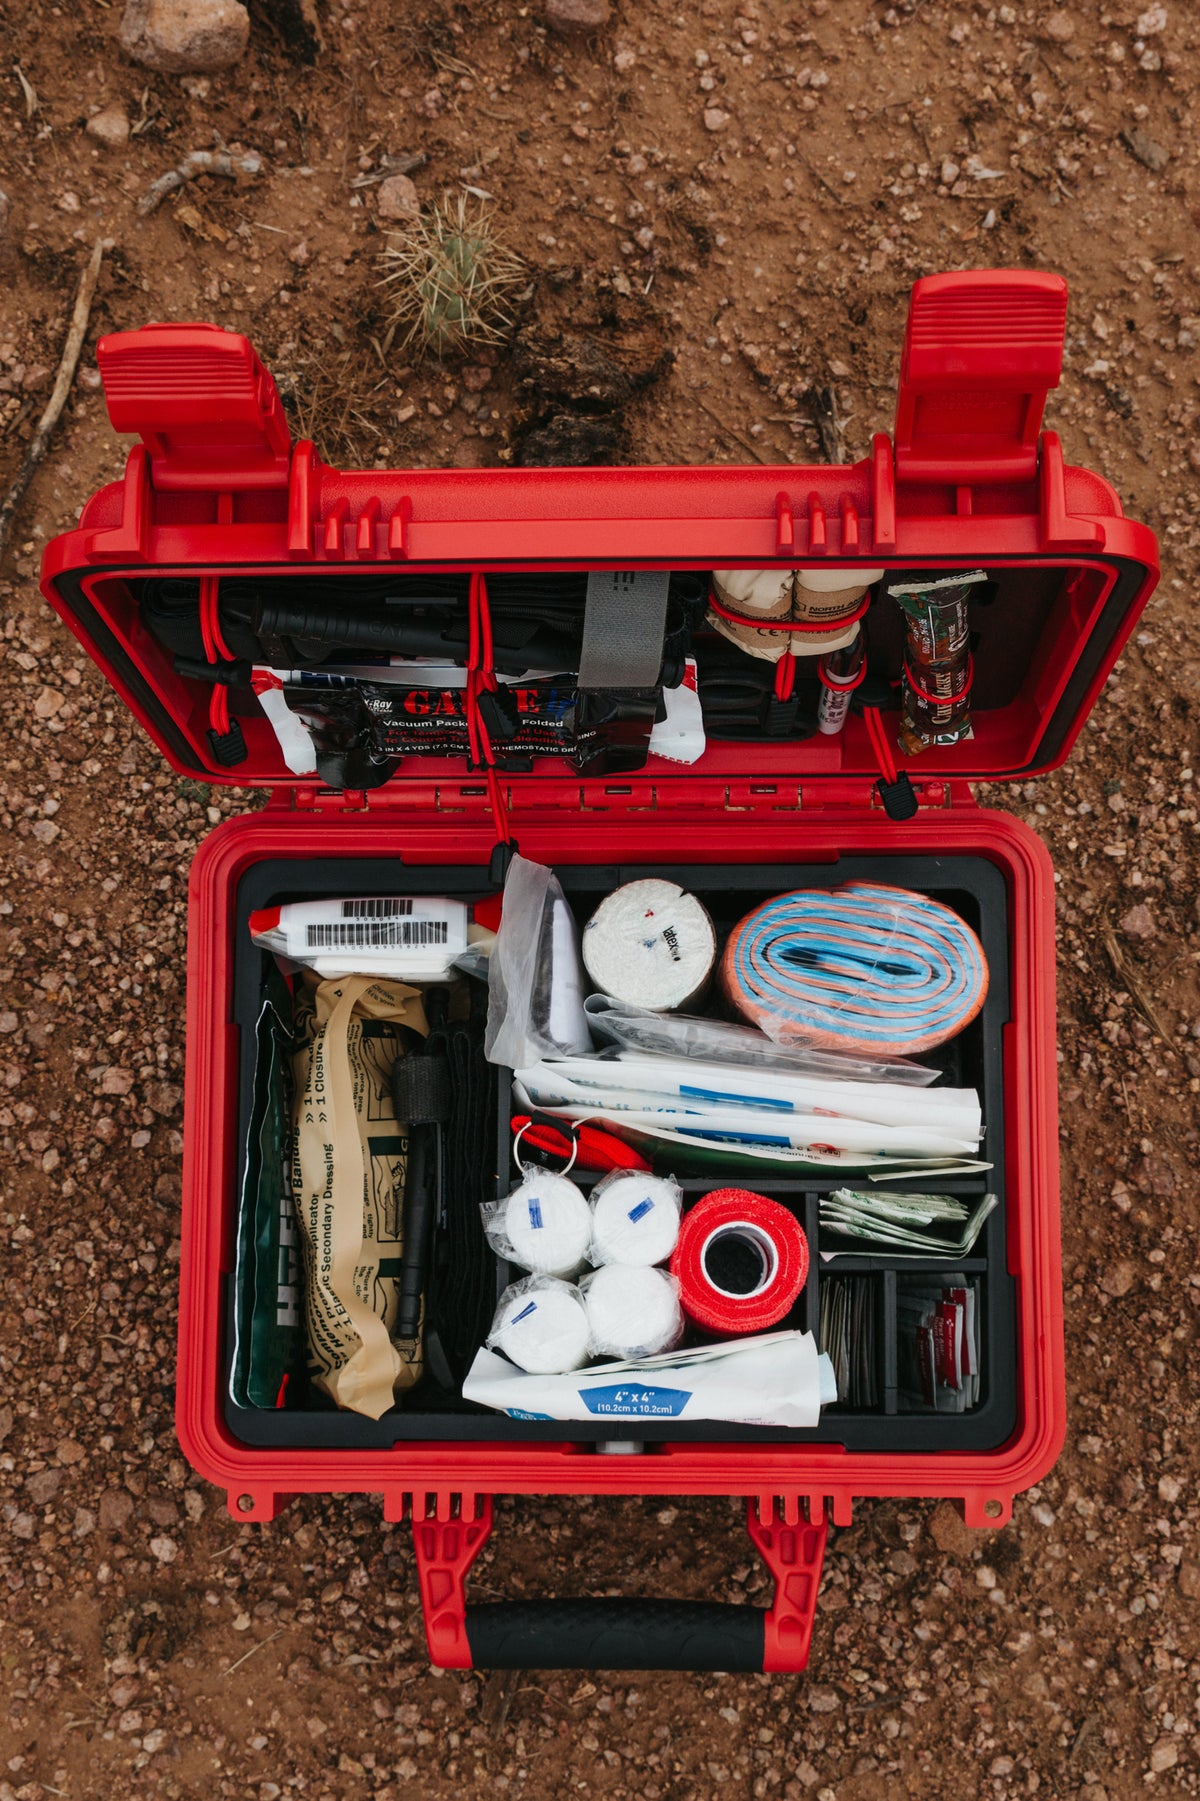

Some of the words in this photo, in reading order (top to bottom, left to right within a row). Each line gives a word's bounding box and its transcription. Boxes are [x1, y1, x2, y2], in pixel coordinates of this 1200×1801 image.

[404, 688, 540, 714] GAE
[522, 720, 564, 728] Folded
[502, 745, 558, 753] HEMOSTATIC
[314, 1042, 325, 1092] Closure
[323, 1144, 334, 1200] Dressing
[322, 1202, 334, 1272] Secondary
[359, 1266, 367, 1278] the
[363, 1266, 374, 1291] Secure
[322, 1274, 346, 1316] Elastic
[597, 1404, 631, 1412] (10.2cm
[640, 1404, 673, 1414] 10.2cm)
[614, 1392, 628, 1402] 4"
[631, 1394, 639, 1402] x
[641, 1392, 655, 1402] 4"
